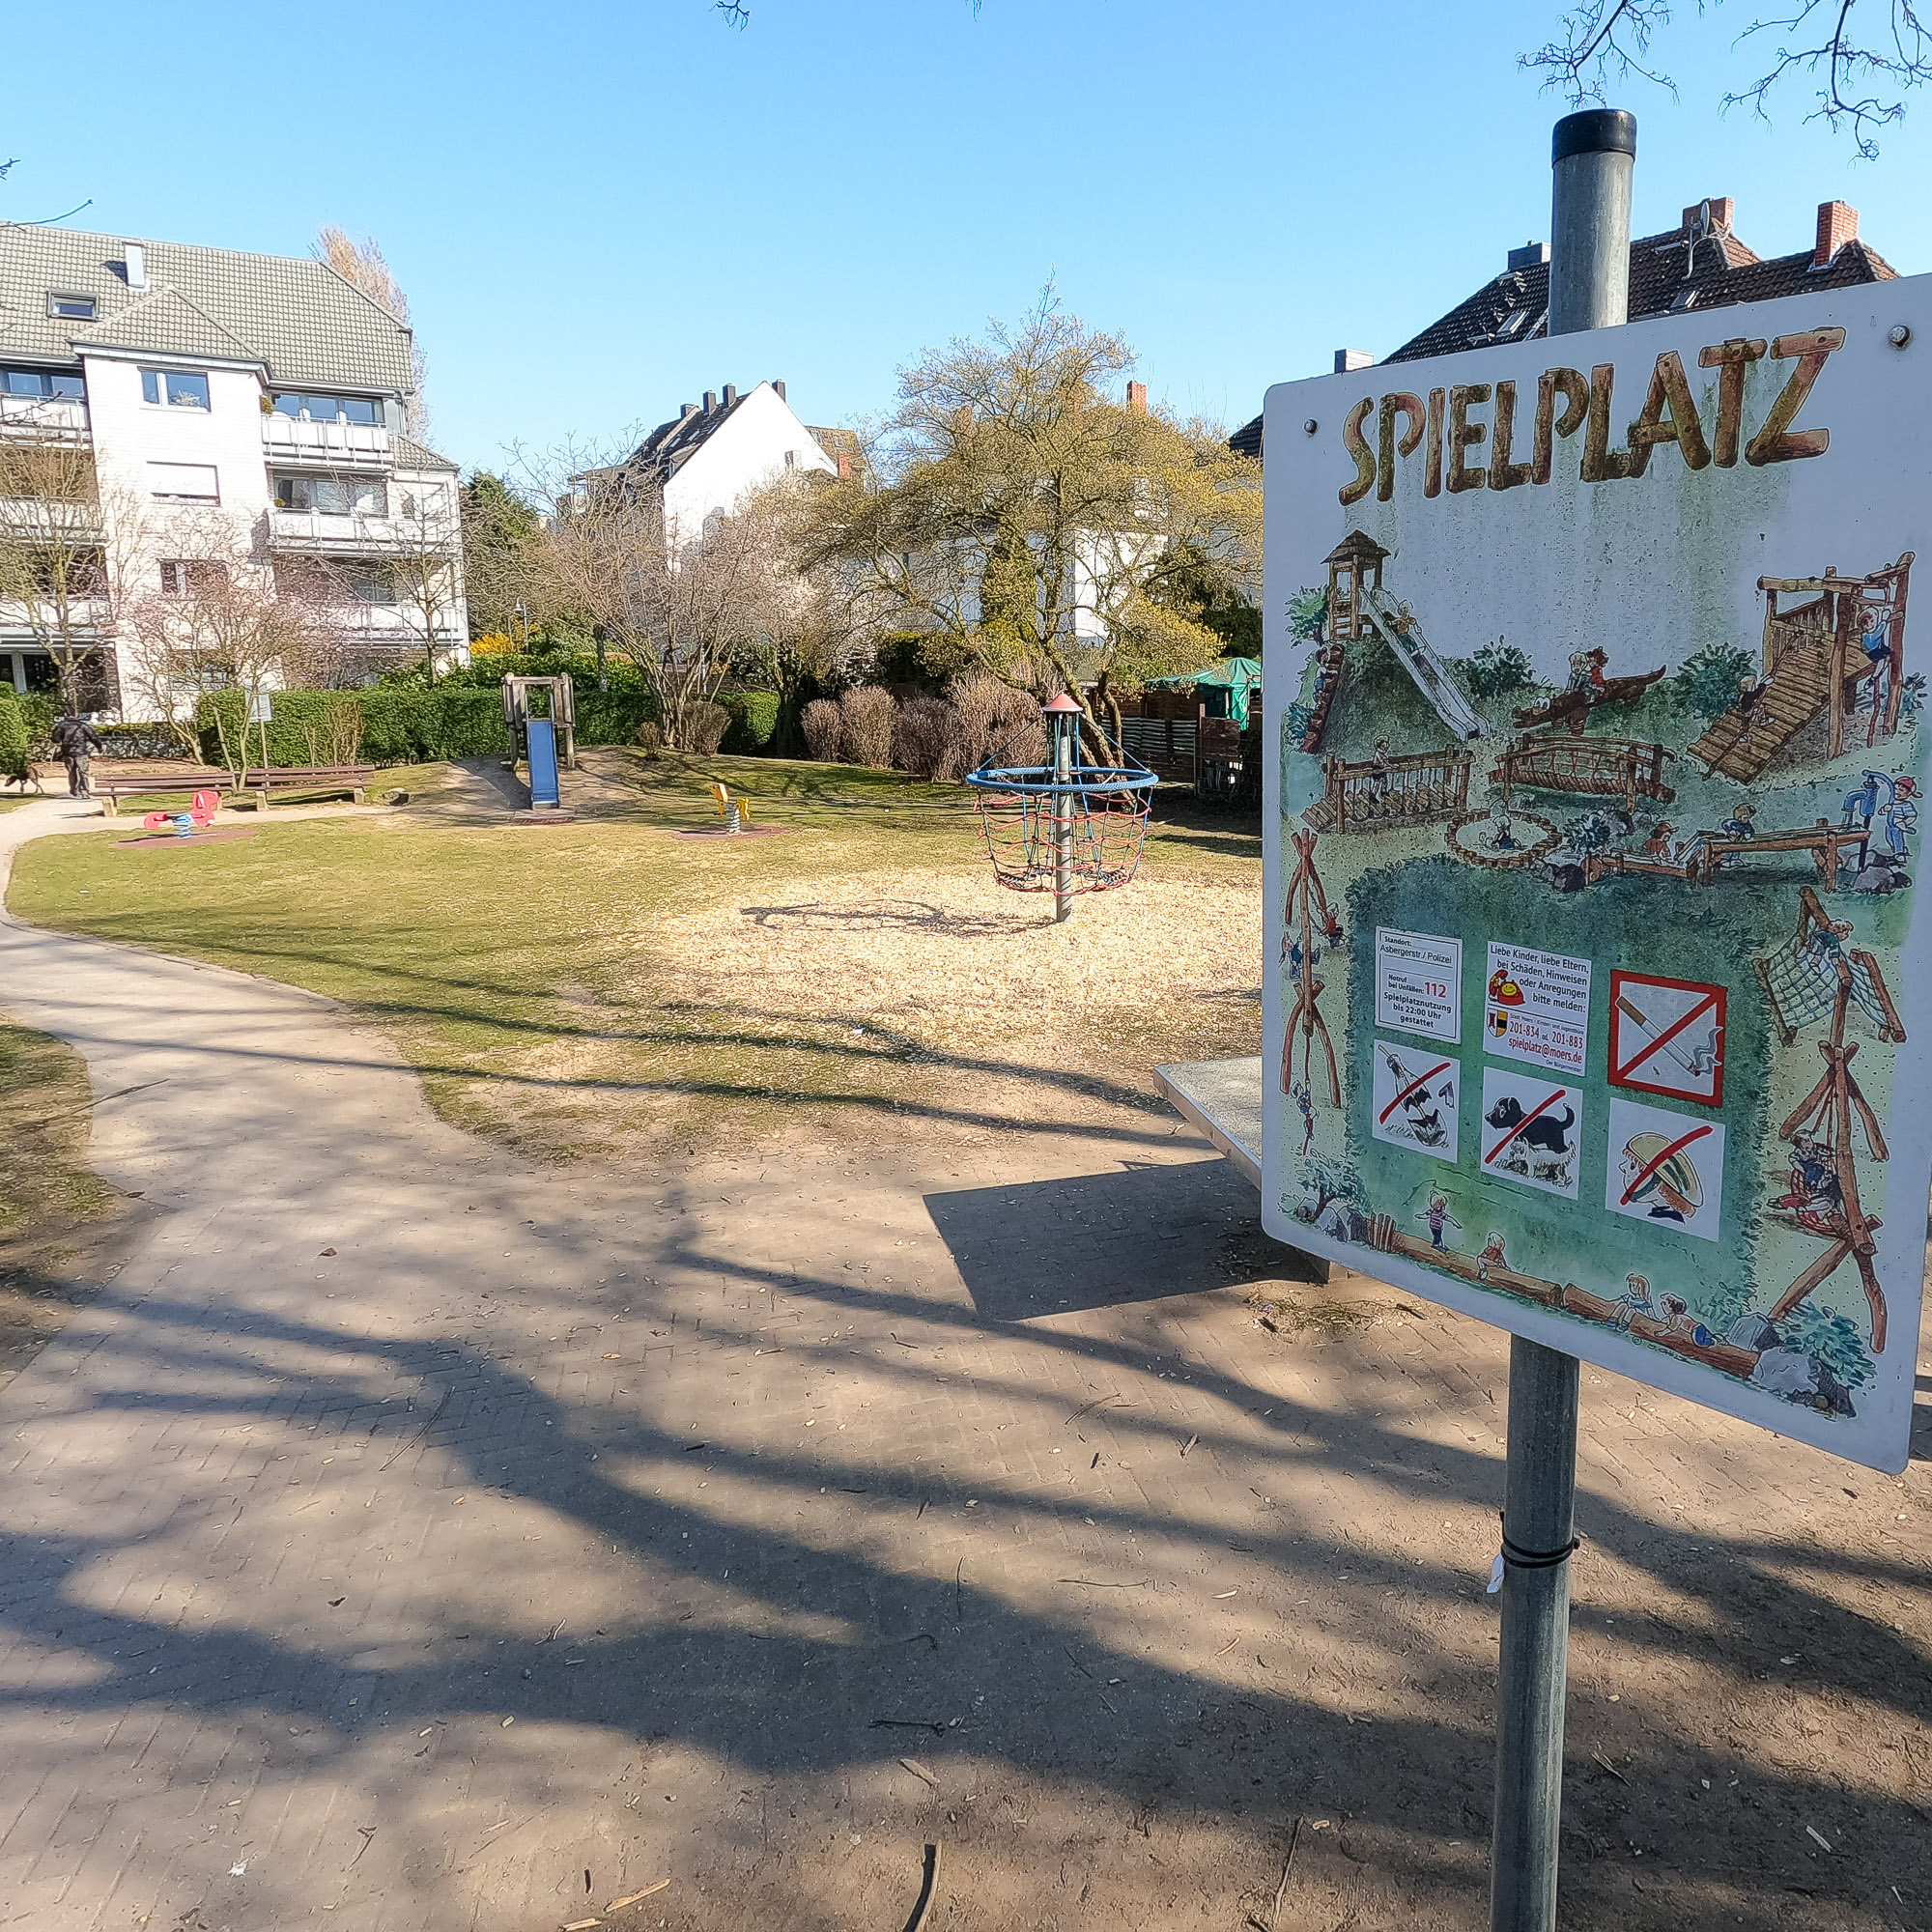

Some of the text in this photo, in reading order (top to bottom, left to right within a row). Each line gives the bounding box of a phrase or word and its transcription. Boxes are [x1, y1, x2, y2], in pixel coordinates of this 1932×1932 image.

[1339, 327, 1846, 506] SPIELPLATZ
[1384, 936, 1411, 945] Standort:
[1427, 952, 1452, 963] Polizei
[1490, 944, 1590, 974] Liebe Kinder, liebe Eltern,
[1388, 974, 1407, 982] Notruf
[1496, 958, 1588, 985] bei Schäden, Hinweisen
[1398, 983, 1425, 994] Unfällen:
[1424, 981, 1447, 998] 112
[1519, 978, 1587, 999] oder Anregungen
[1383, 991, 1452, 1013] Spielplatznutzung
[1393, 1003, 1442, 1019] bis 22:00 Uhr
[1532, 992, 1587, 1012] bitte melden:
[1400, 1015, 1435, 1028] gestattet
[1509, 1020, 1541, 1038] 201-834
[1551, 1031, 1584, 1049] 201-883
[1508, 1037, 1583, 1064] spielplatz@moers.de
